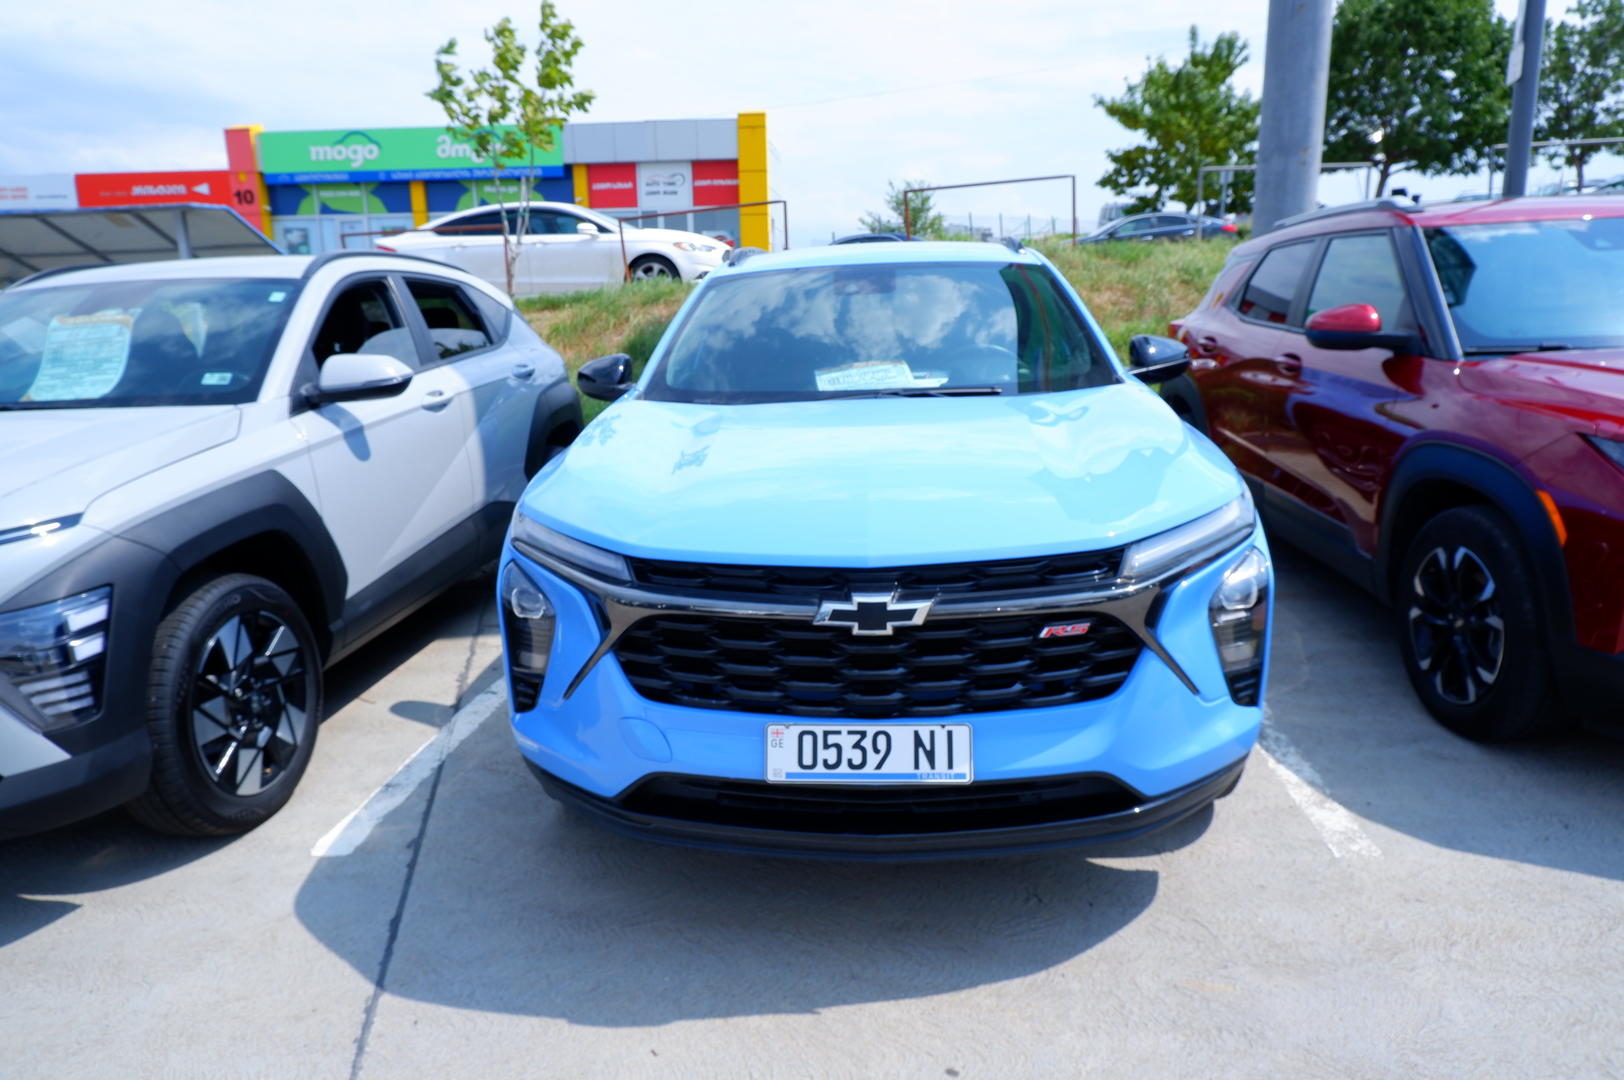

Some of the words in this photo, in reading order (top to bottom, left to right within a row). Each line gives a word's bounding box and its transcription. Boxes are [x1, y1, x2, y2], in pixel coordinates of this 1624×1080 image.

[309, 143, 379, 168] mogo
[234, 190, 255, 204] 10
[1039, 622, 1091, 638] RS
[770, 738, 785, 748] GE
[798, 730, 892, 770] 0539
[913, 730, 953, 770] NI
[916, 772, 955, 780] TRANSIT
